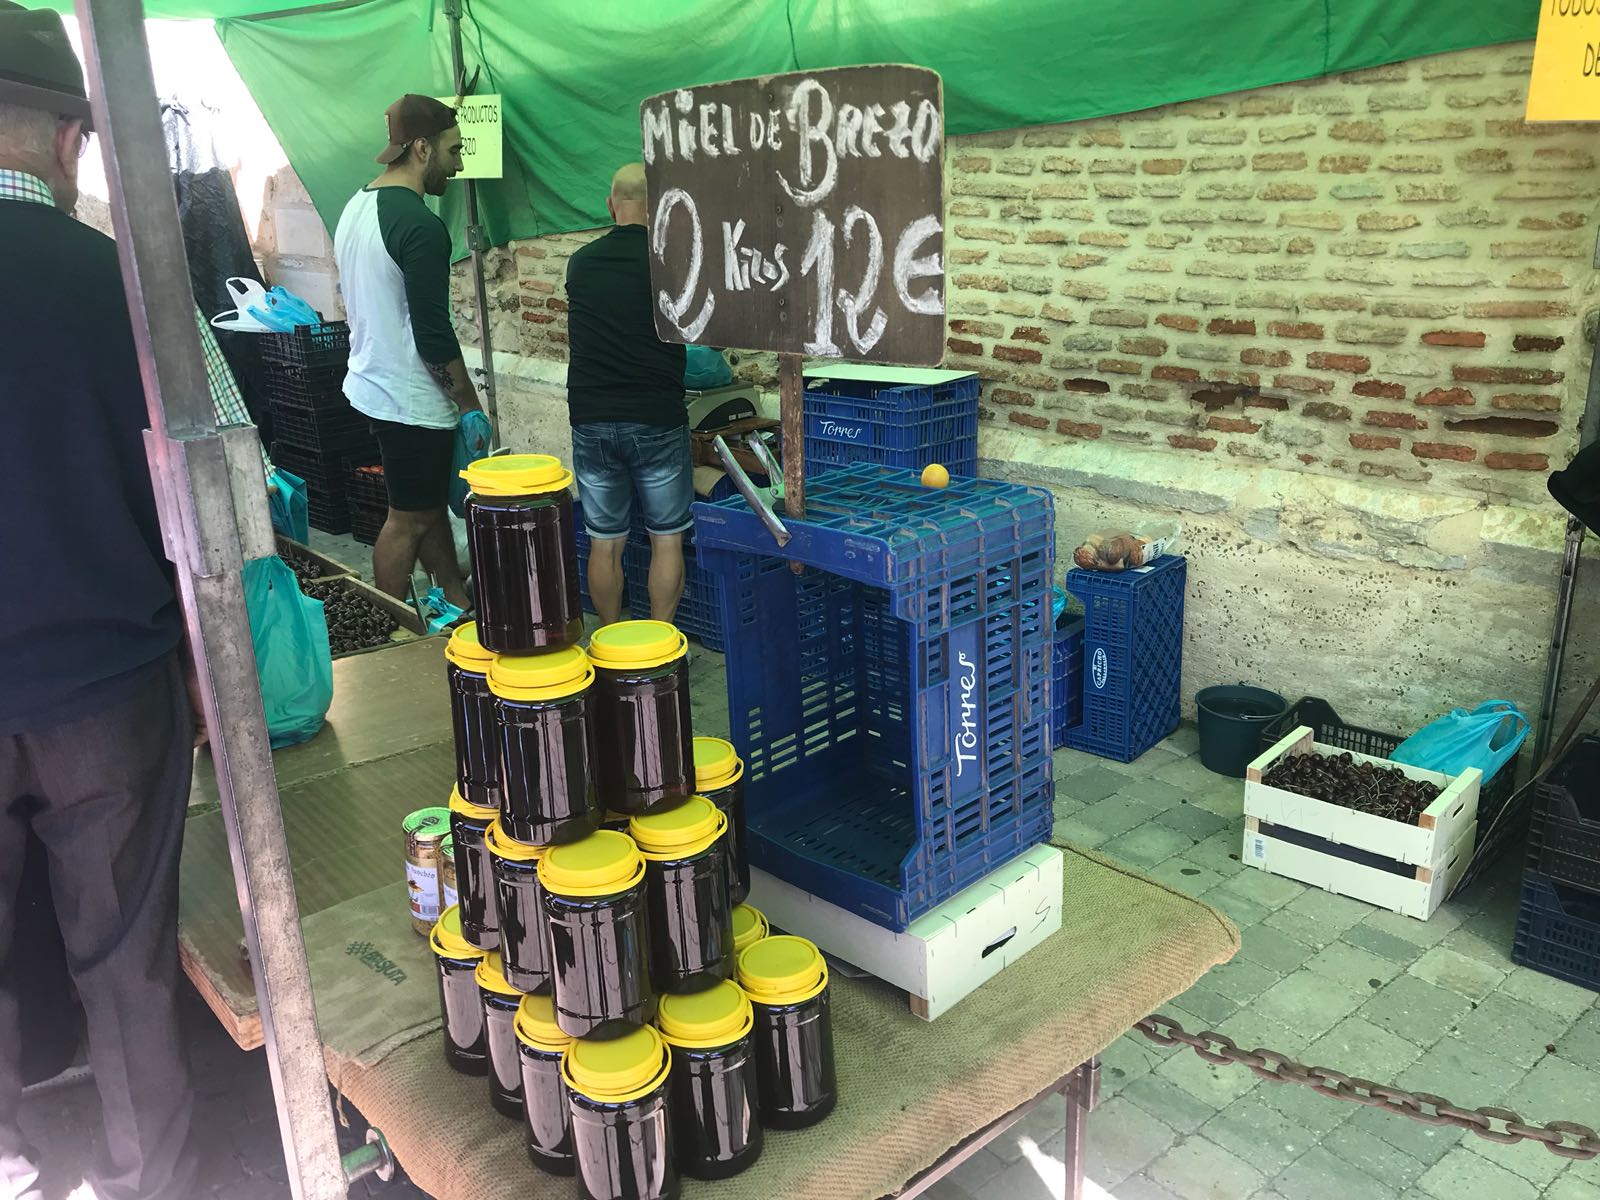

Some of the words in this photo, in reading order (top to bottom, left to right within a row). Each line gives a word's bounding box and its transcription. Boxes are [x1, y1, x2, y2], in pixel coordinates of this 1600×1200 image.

[750, 108, 783, 152] DE
[775, 78, 940, 207] BREZO
[652, 187, 716, 343] 2
[819, 420, 862, 439] Torres
[955, 651, 977, 777] Torres
